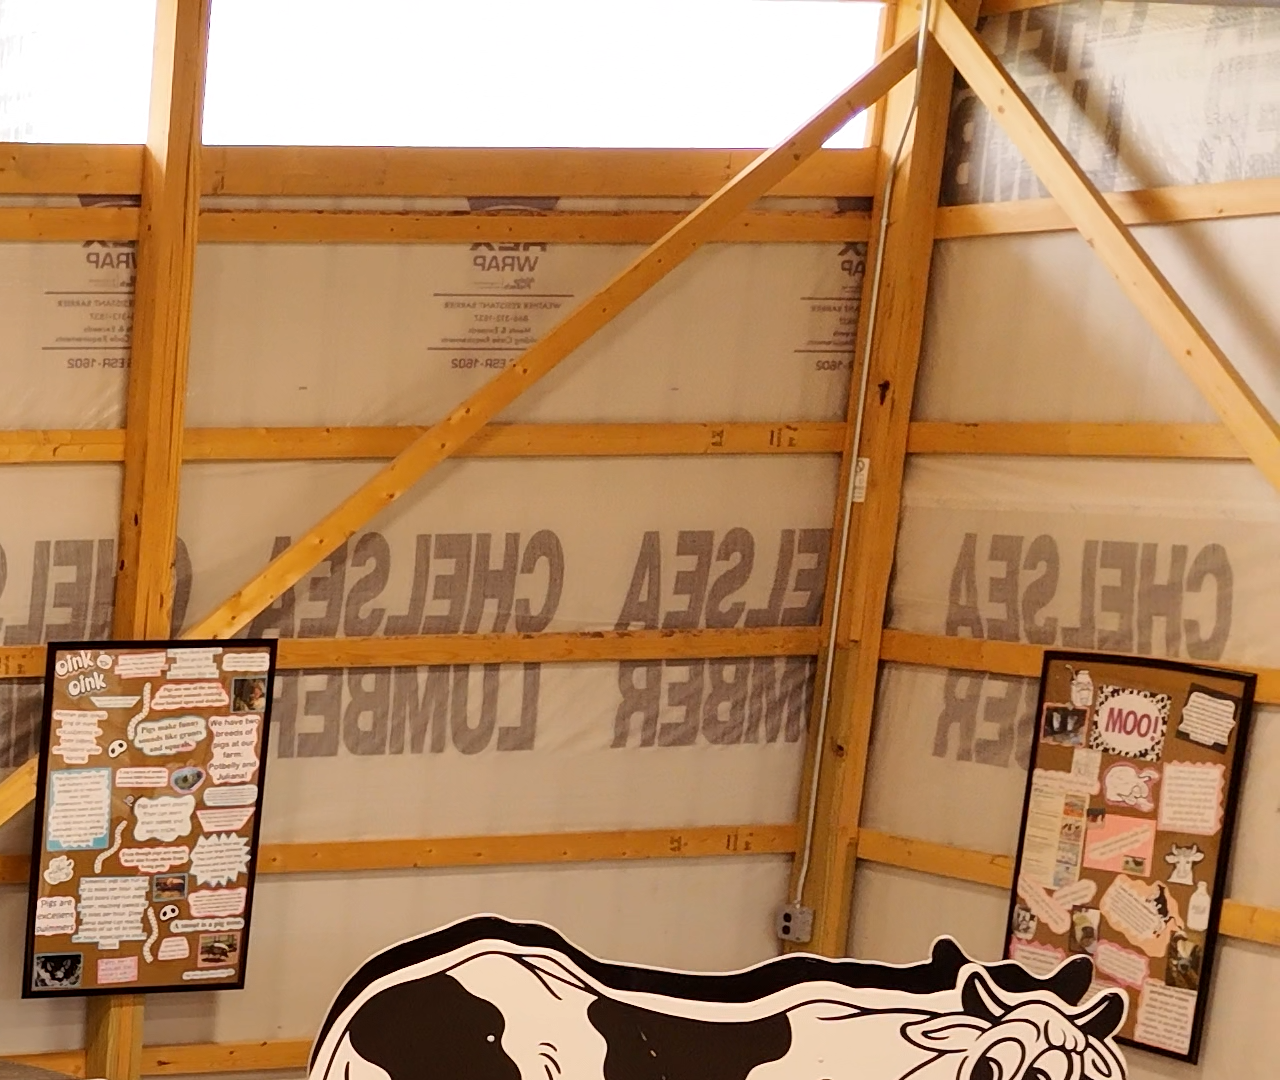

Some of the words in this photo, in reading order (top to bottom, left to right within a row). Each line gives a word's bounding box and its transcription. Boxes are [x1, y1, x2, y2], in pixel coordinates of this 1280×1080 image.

[55, 650, 94, 676] oink
[68, 671, 107, 696] oink
[141, 726, 156, 734] Pigs
[1105, 707, 1159, 743] MOO!
[41, 900, 56, 908] Pigs
